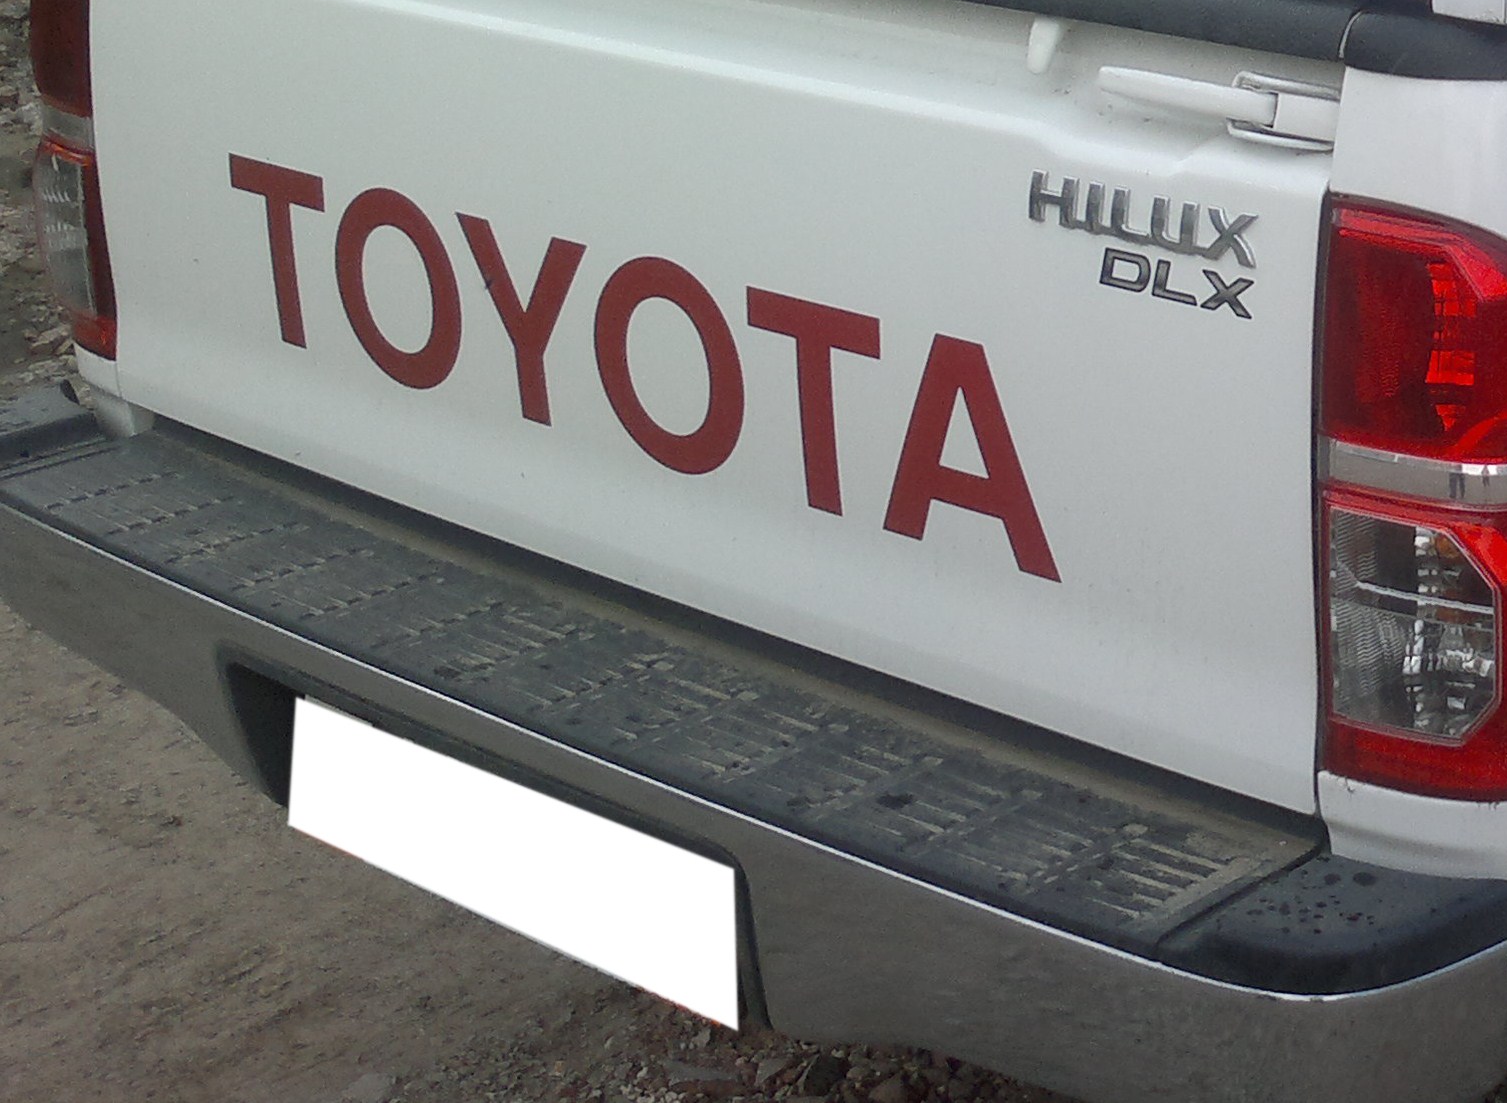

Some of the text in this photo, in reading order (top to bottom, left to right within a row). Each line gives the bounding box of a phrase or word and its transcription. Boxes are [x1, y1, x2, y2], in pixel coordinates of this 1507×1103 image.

[1029, 168, 1259, 269] HILUX
[1099, 247, 1255, 319] DLX
[229, 152, 1061, 583] TOYOTA
